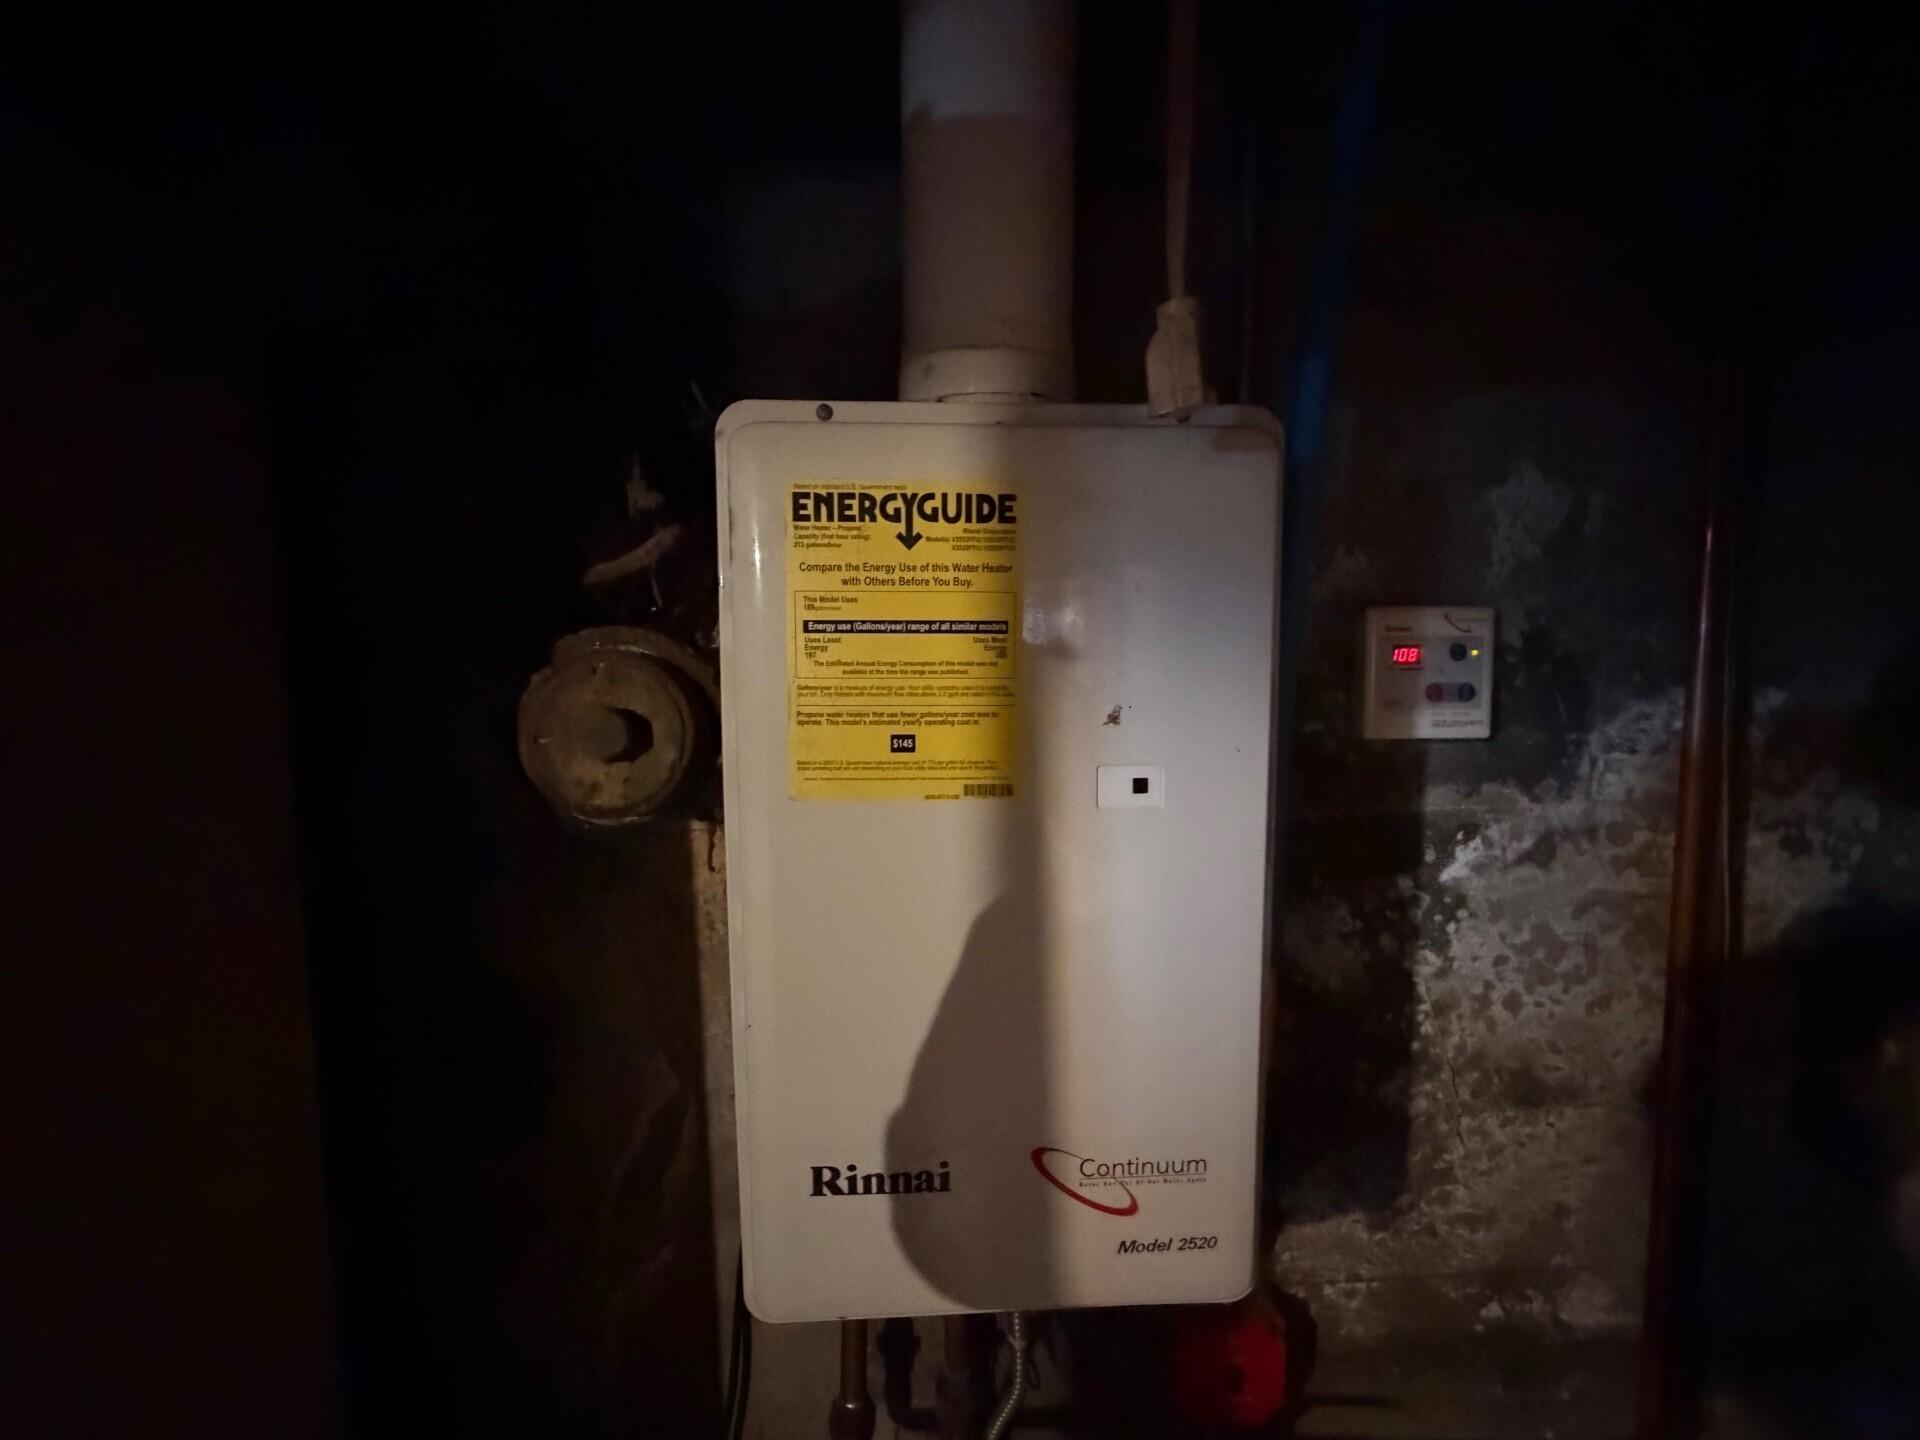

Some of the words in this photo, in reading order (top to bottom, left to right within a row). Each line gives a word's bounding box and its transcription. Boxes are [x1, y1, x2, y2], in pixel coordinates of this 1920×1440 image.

[792, 491, 1017, 524] ENERGYGUIDE
[799, 562, 846, 574] Compare
[847, 562, 861, 572] the
[863, 563, 896, 574] Energy
[899, 563, 918, 573] Use
[919, 563, 930, 573] of
[931, 563, 949, 573] this
[952, 563, 980, 573] Water
[982, 563, 1013, 573] Heater
[841, 577, 861, 587] with
[863, 577, 896, 587] Others
[899, 577, 930, 587] Before
[932, 577, 950, 587] You
[953, 577, 974, 589] Buy.
[808, 622, 836, 632] Energy
[853, 622, 906, 632] (Gallons/year)
[907, 624, 930, 632] range
[931, 622, 940, 631] of
[940, 622, 950, 631] all
[951, 622, 977, 631] similar
[978, 623, 1007, 631] models
[1392, 648, 1419, 662] 108
[892, 738, 914, 749] $145
[1079, 1156, 1208, 1178] Continuum
[809, 1161, 952, 1198] Rinnai
[1117, 1237, 1173, 1255] Model
[1177, 1235, 1218, 1252] 2520
